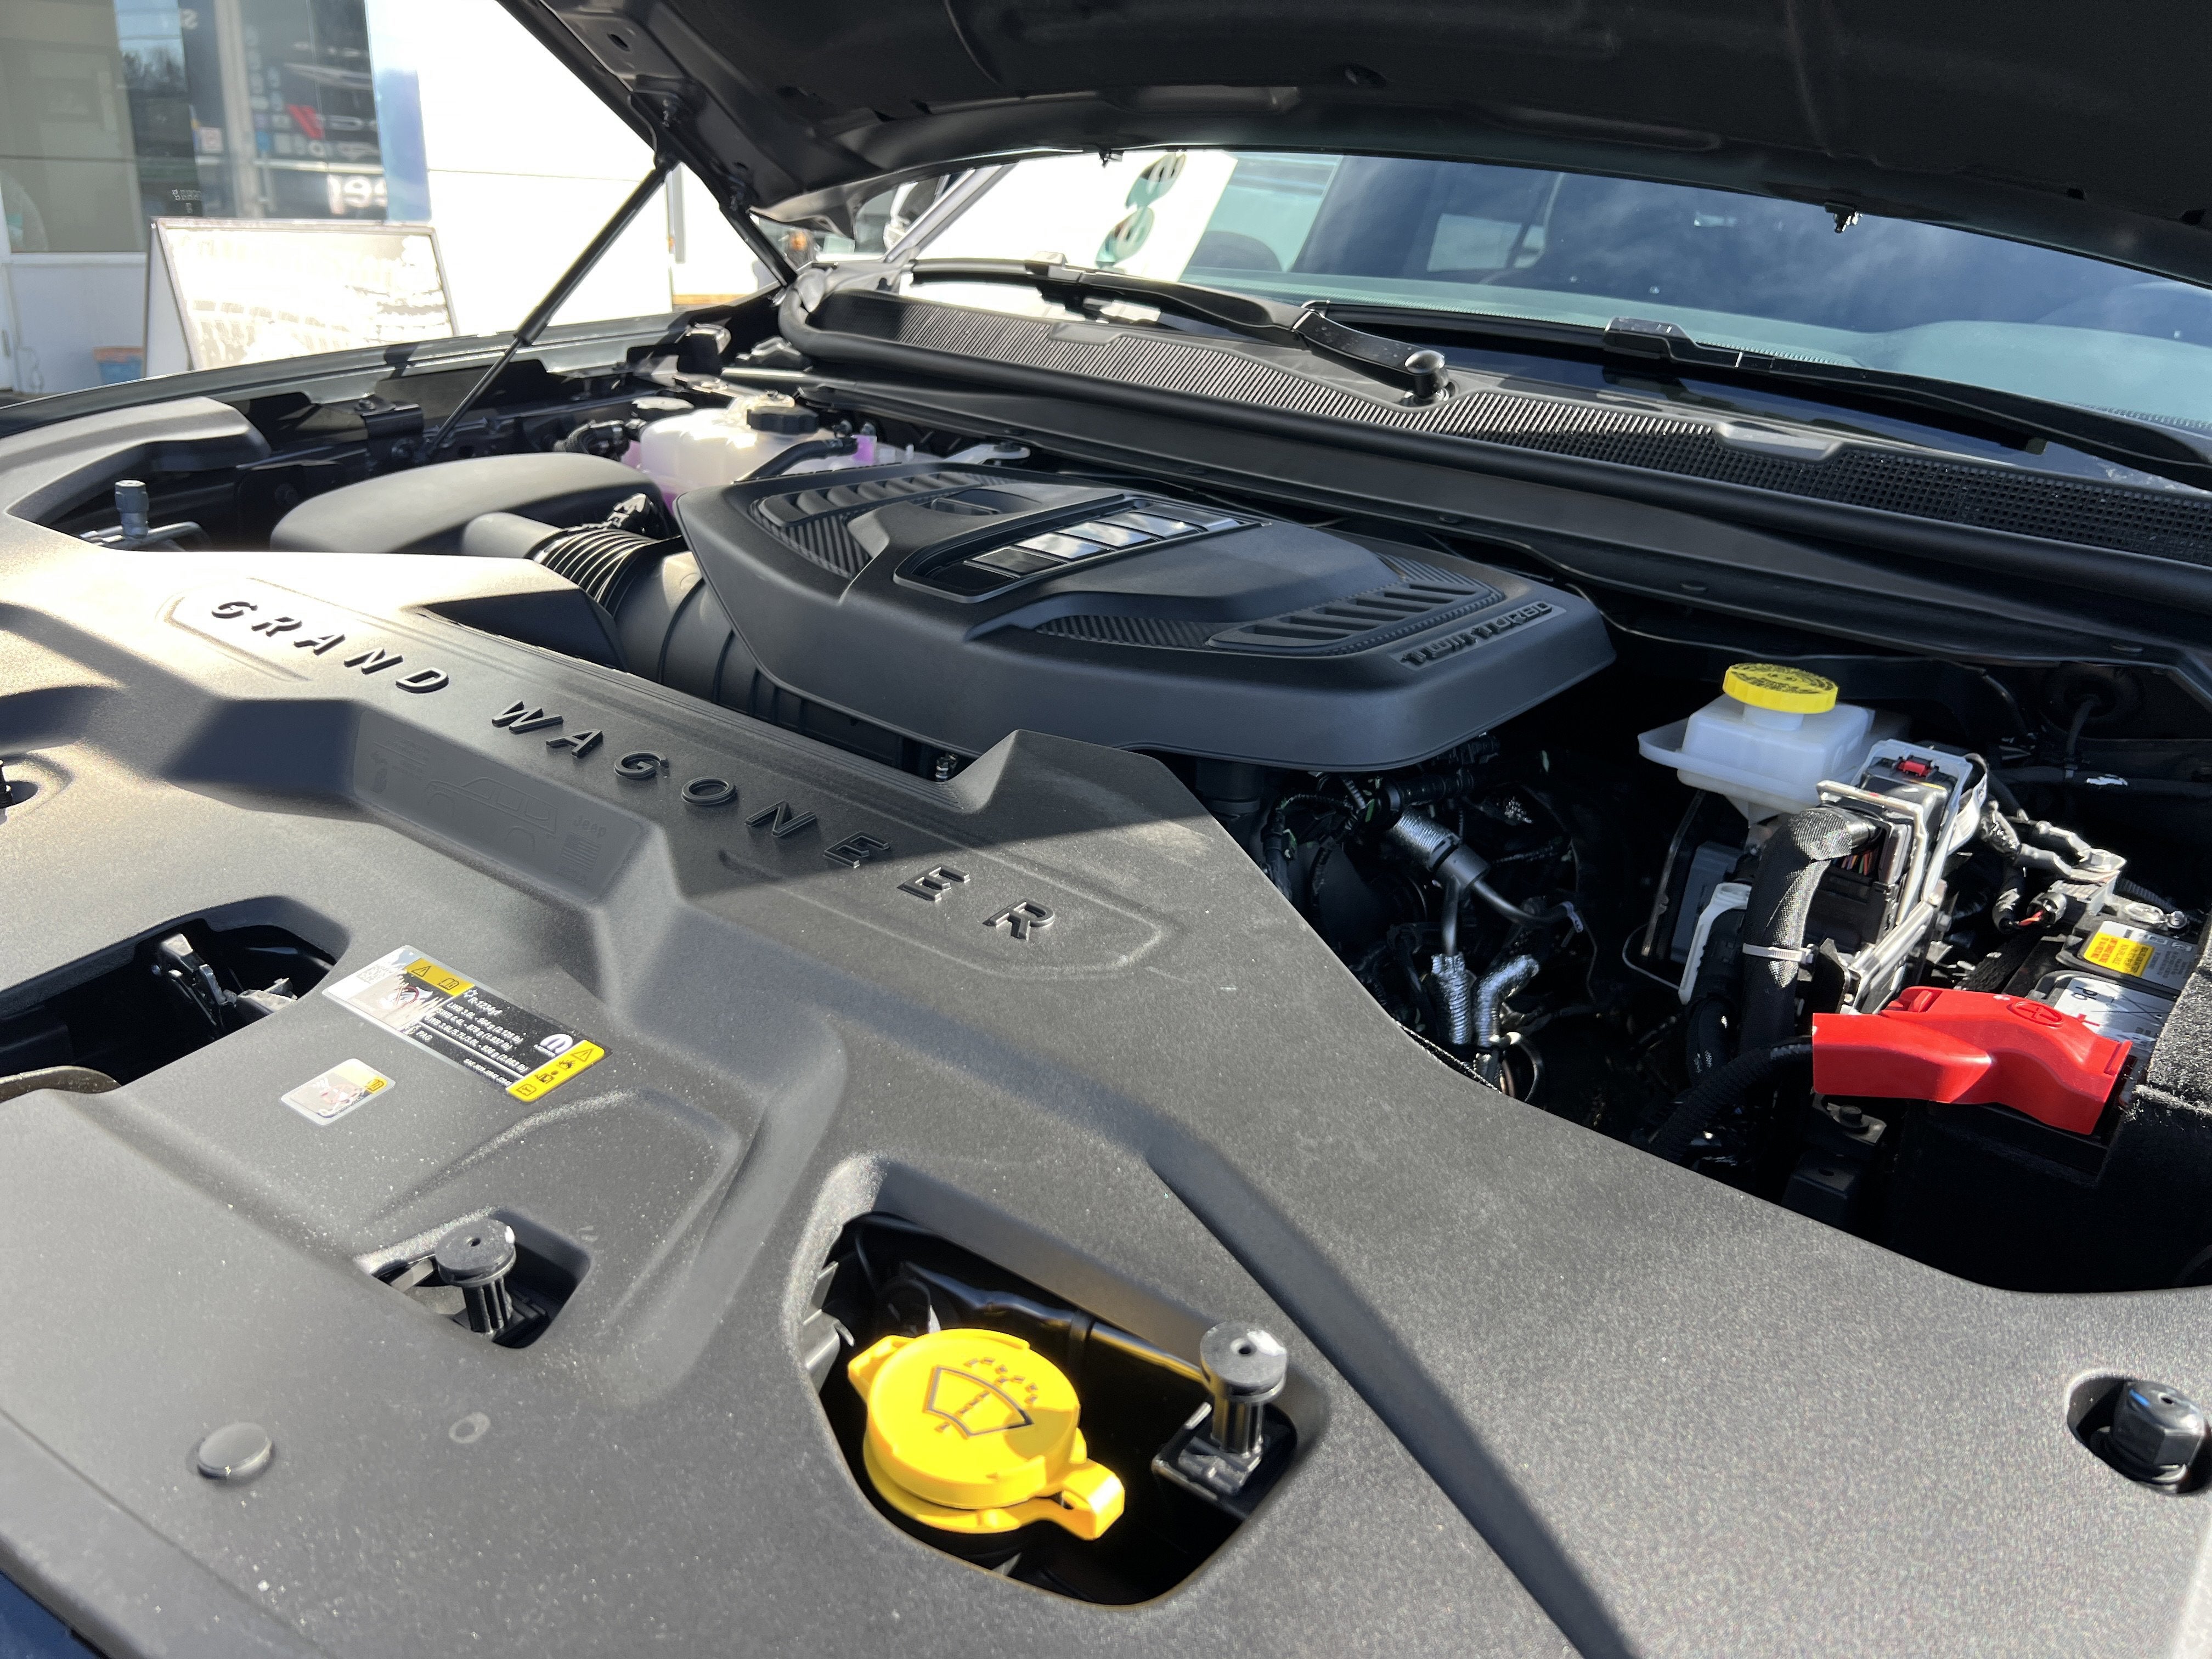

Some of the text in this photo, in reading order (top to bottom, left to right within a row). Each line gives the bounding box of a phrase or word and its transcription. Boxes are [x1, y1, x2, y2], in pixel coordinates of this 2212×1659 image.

[1471, 602, 1553, 639] TURBO
[212, 601, 1056, 940] GRAND WAGONEER
[573, 815, 606, 838] Jeep
[447, 1002, 464, 1012] LWB
[467, 997, 503, 1015] R-1234yf
[416, 1030, 433, 1042] PAG
